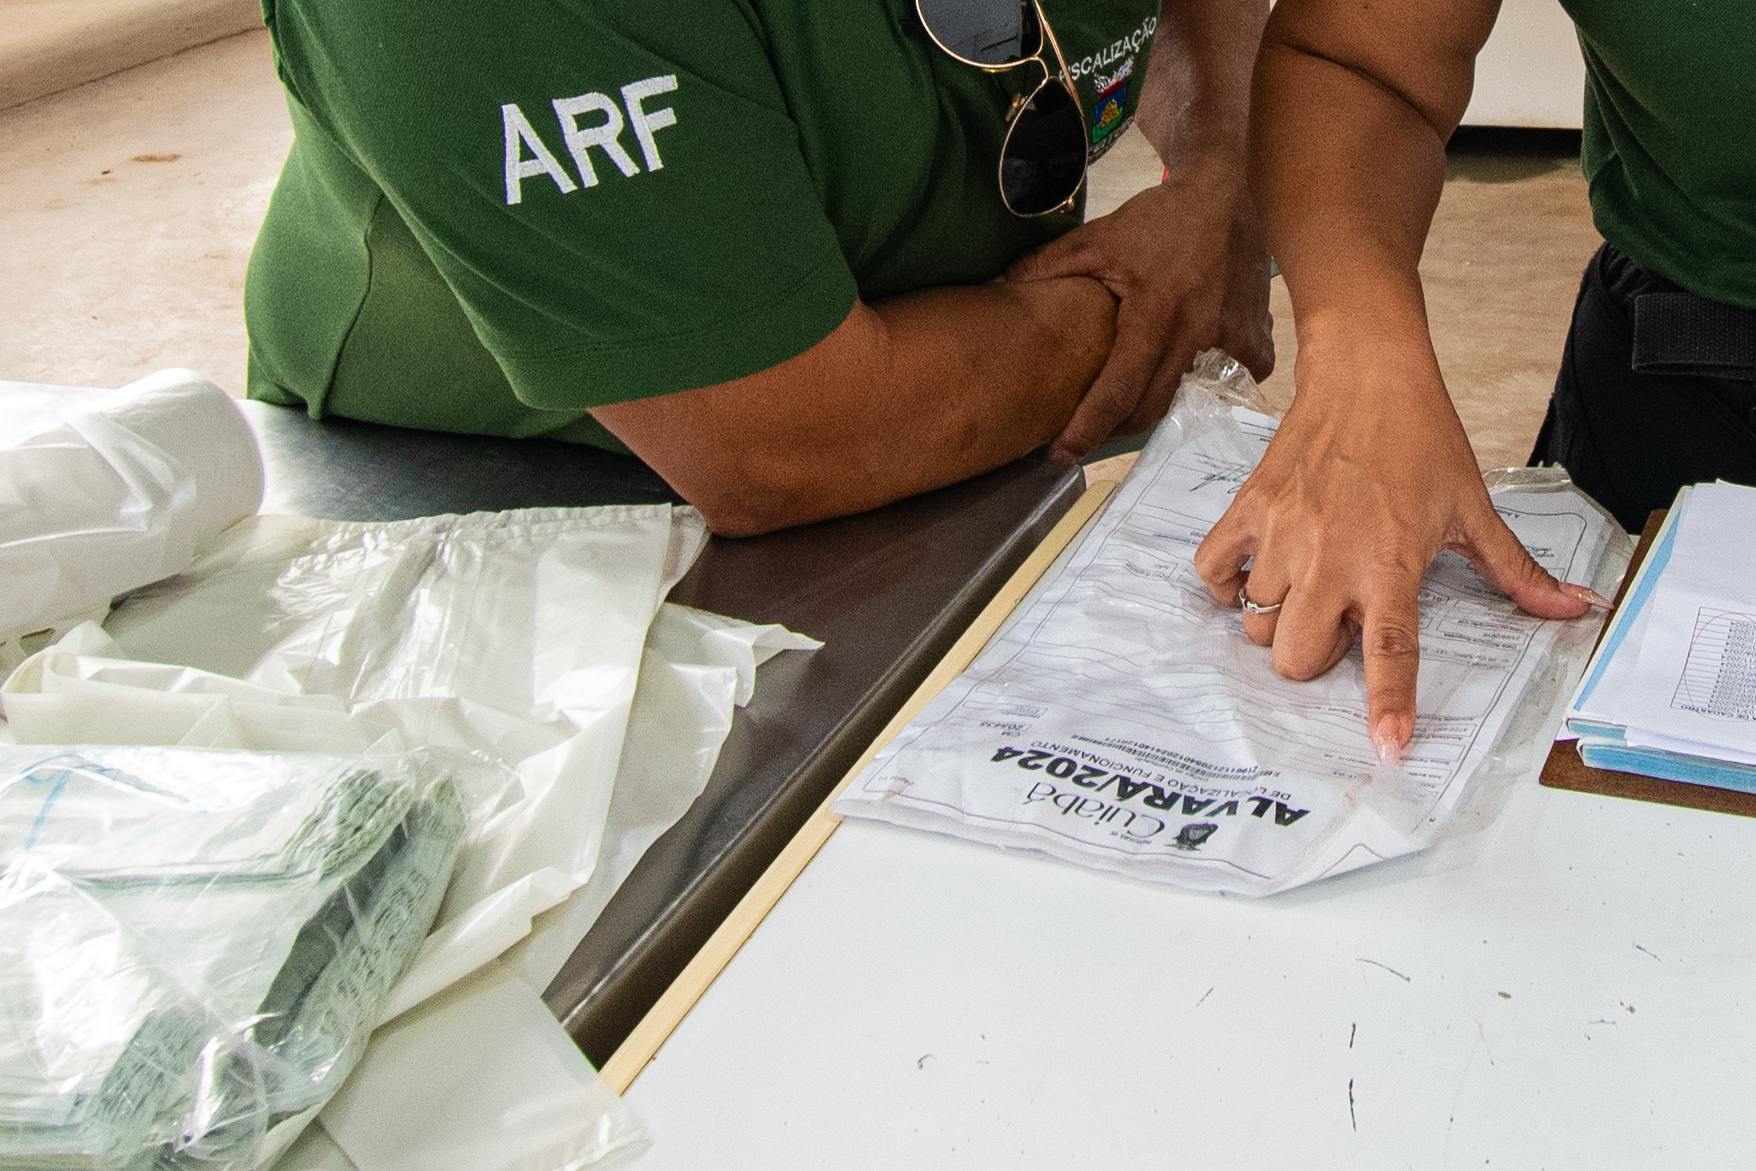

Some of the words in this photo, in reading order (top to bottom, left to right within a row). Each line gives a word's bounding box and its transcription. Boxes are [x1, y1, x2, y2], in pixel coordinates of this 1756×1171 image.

[502, 73, 679, 204] ARF
[1030, 741, 1153, 780] FUNCIONAMENTO
[1155, 775, 1165, 783] E
[989, 746, 1311, 828] ALVARÁ/2024
[1021, 782, 1165, 838] Cuiabá
[1270, 790, 1292, 801] DE
